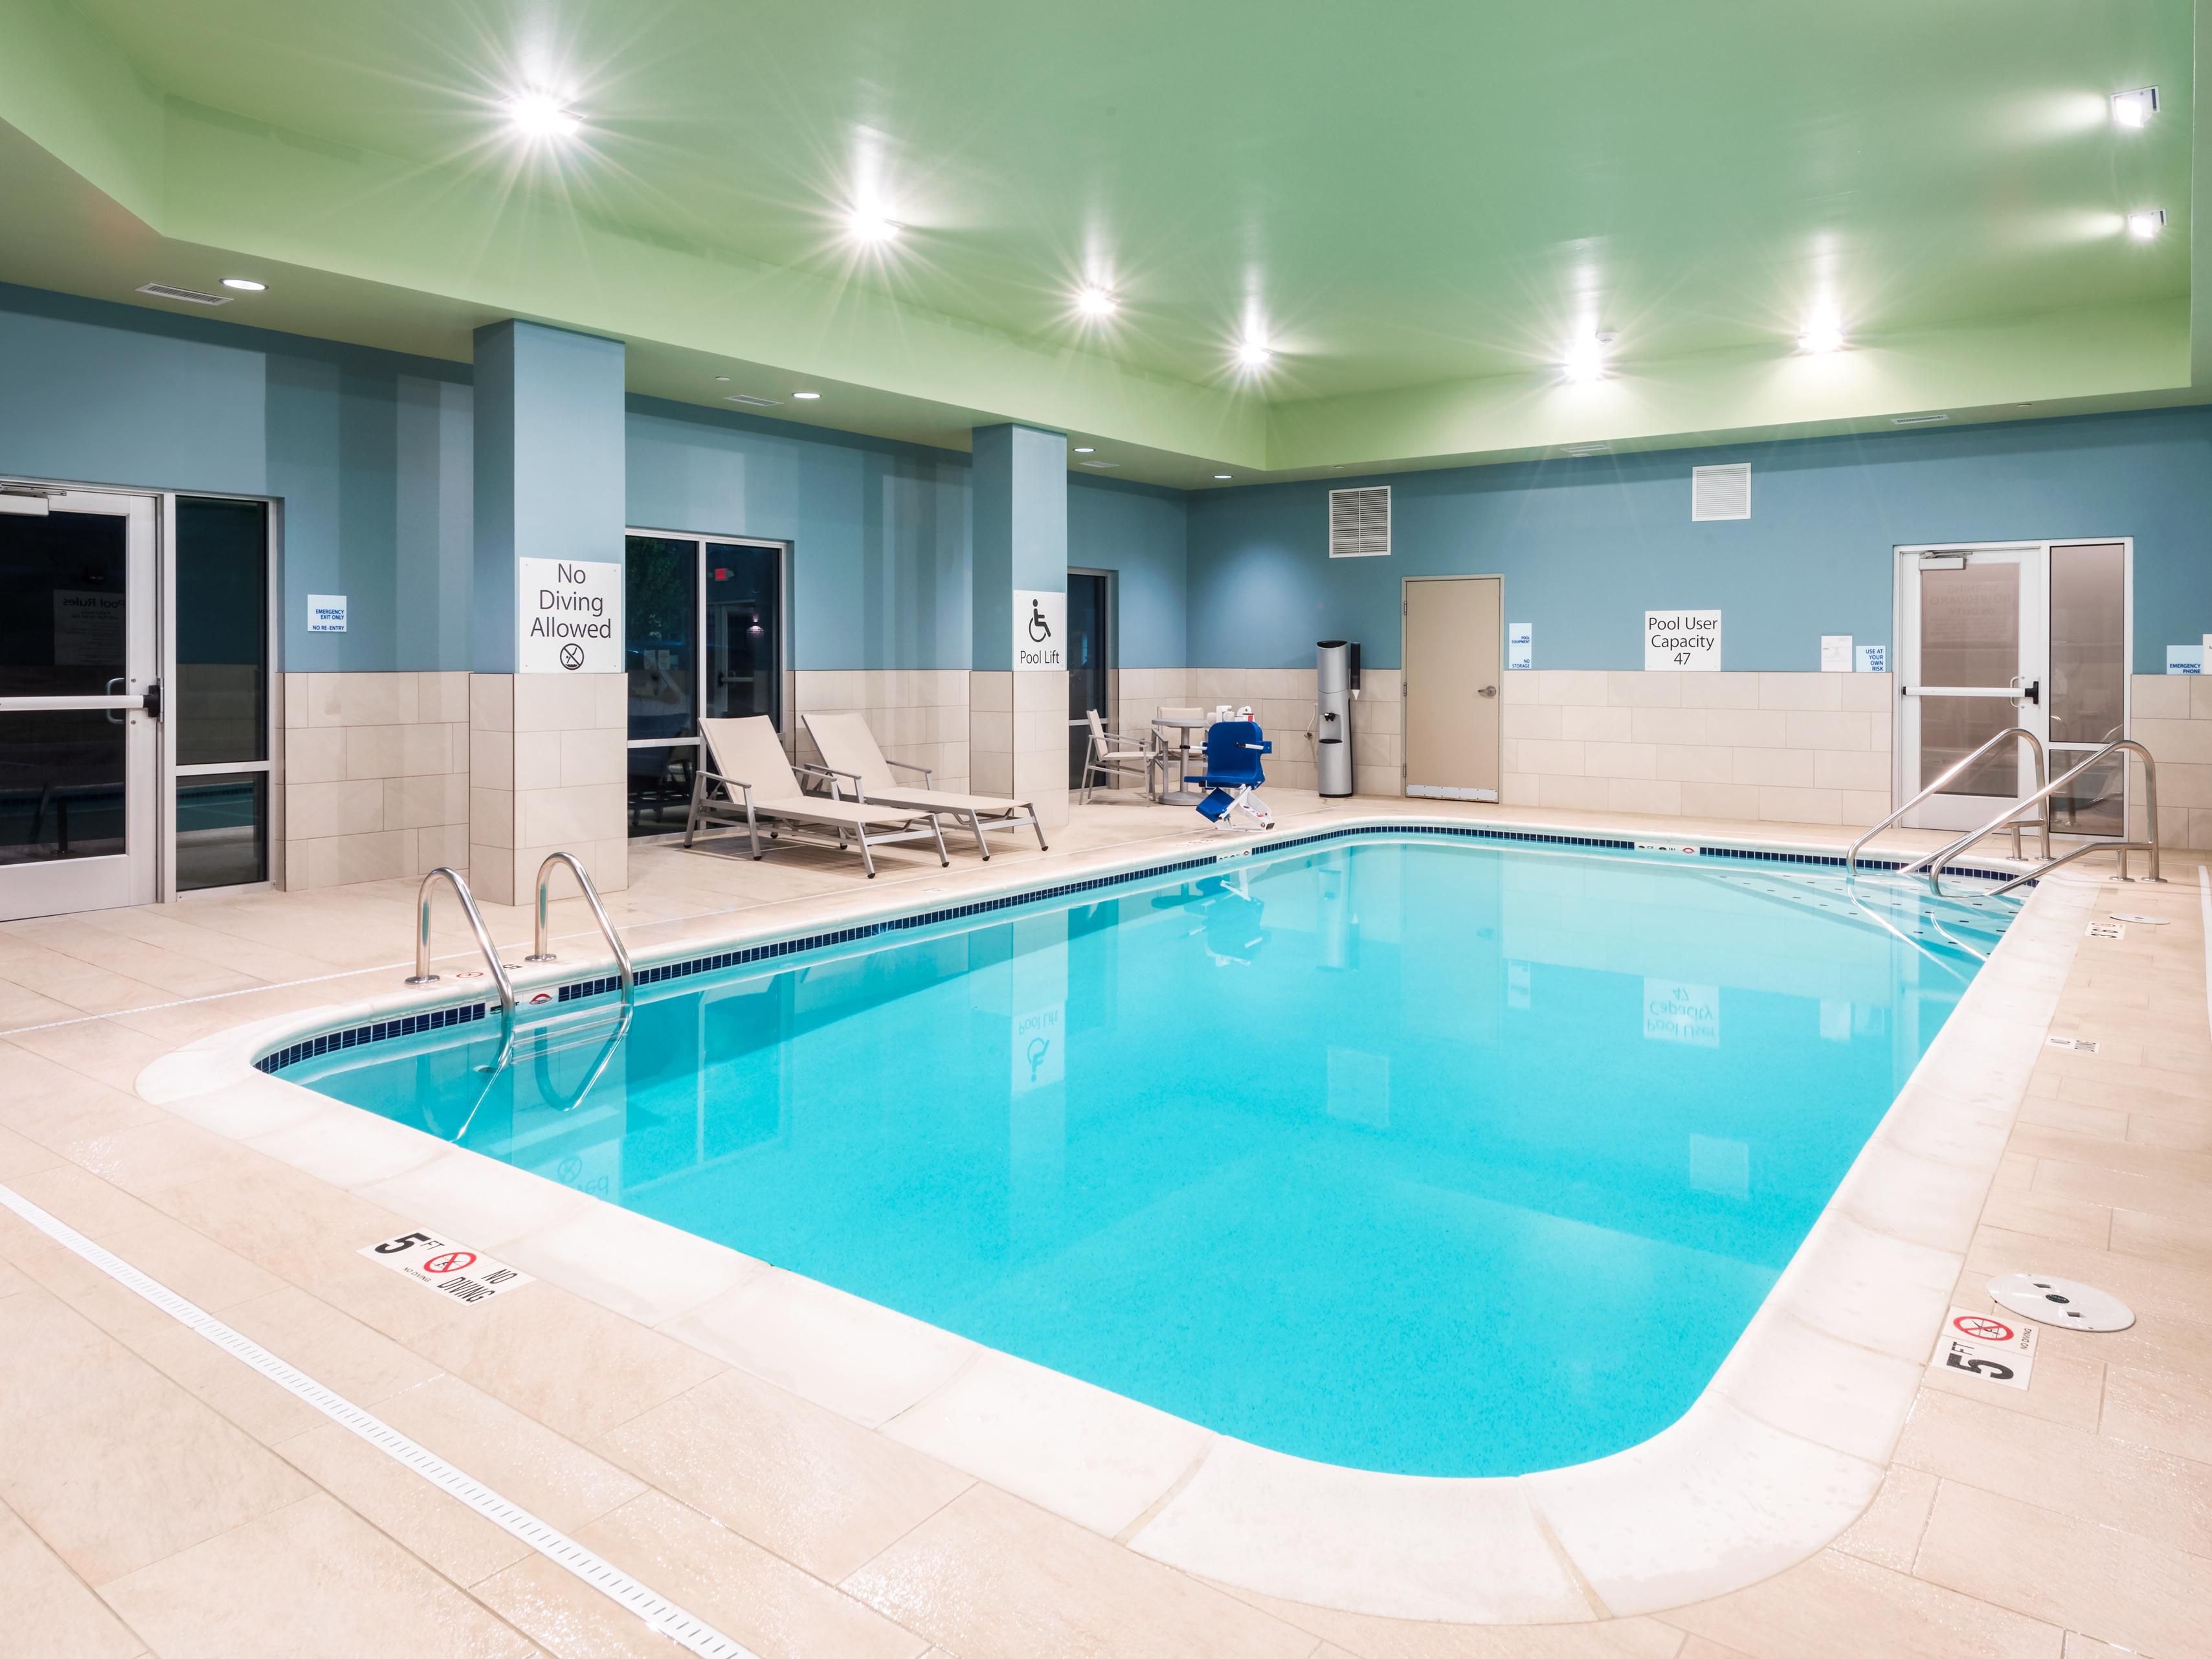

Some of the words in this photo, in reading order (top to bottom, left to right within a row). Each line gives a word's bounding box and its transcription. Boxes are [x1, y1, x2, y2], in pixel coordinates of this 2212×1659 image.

[558, 563, 586, 584] No
[540, 590, 603, 617] Diving
[530, 616, 611, 638] Allowed
[1649, 616, 1680, 630] Pool
[1685, 617, 1719, 630] User
[1651, 634, 1714, 651] Capacity
[1020, 650, 1042, 664] Pool
[1045, 649, 1060, 664] Lift
[1673, 652, 1691, 665] 47
[374, 1232, 432, 1254] 5
[419, 1240, 445, 1251] FT
[410, 1270, 432, 1283] DIVING
[481, 1269, 518, 1284] NO
[436, 1276, 496, 1303] DIVING
[2022, 1328, 2032, 1343] DIVING
[1951, 1341, 1974, 1355] FT
[2020, 1341, 2028, 1350] NO
[1946, 1352, 2014, 1380] 5
